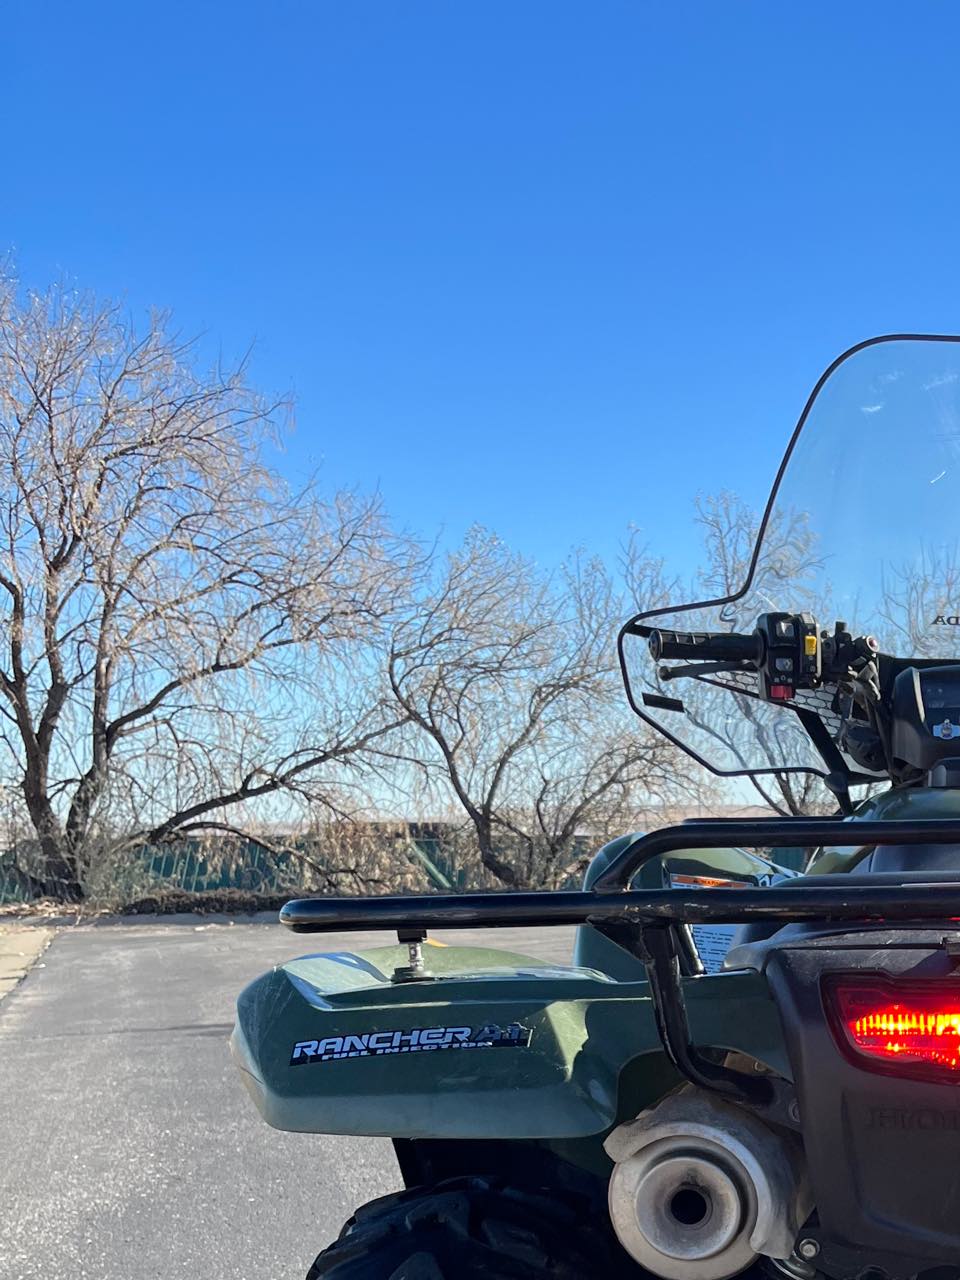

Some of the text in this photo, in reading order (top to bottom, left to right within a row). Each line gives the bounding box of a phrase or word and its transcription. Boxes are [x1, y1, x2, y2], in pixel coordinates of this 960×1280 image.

[292, 1026, 472, 1059] RANCHER
[321, 1040, 493, 1061] FUEL INJECTION
